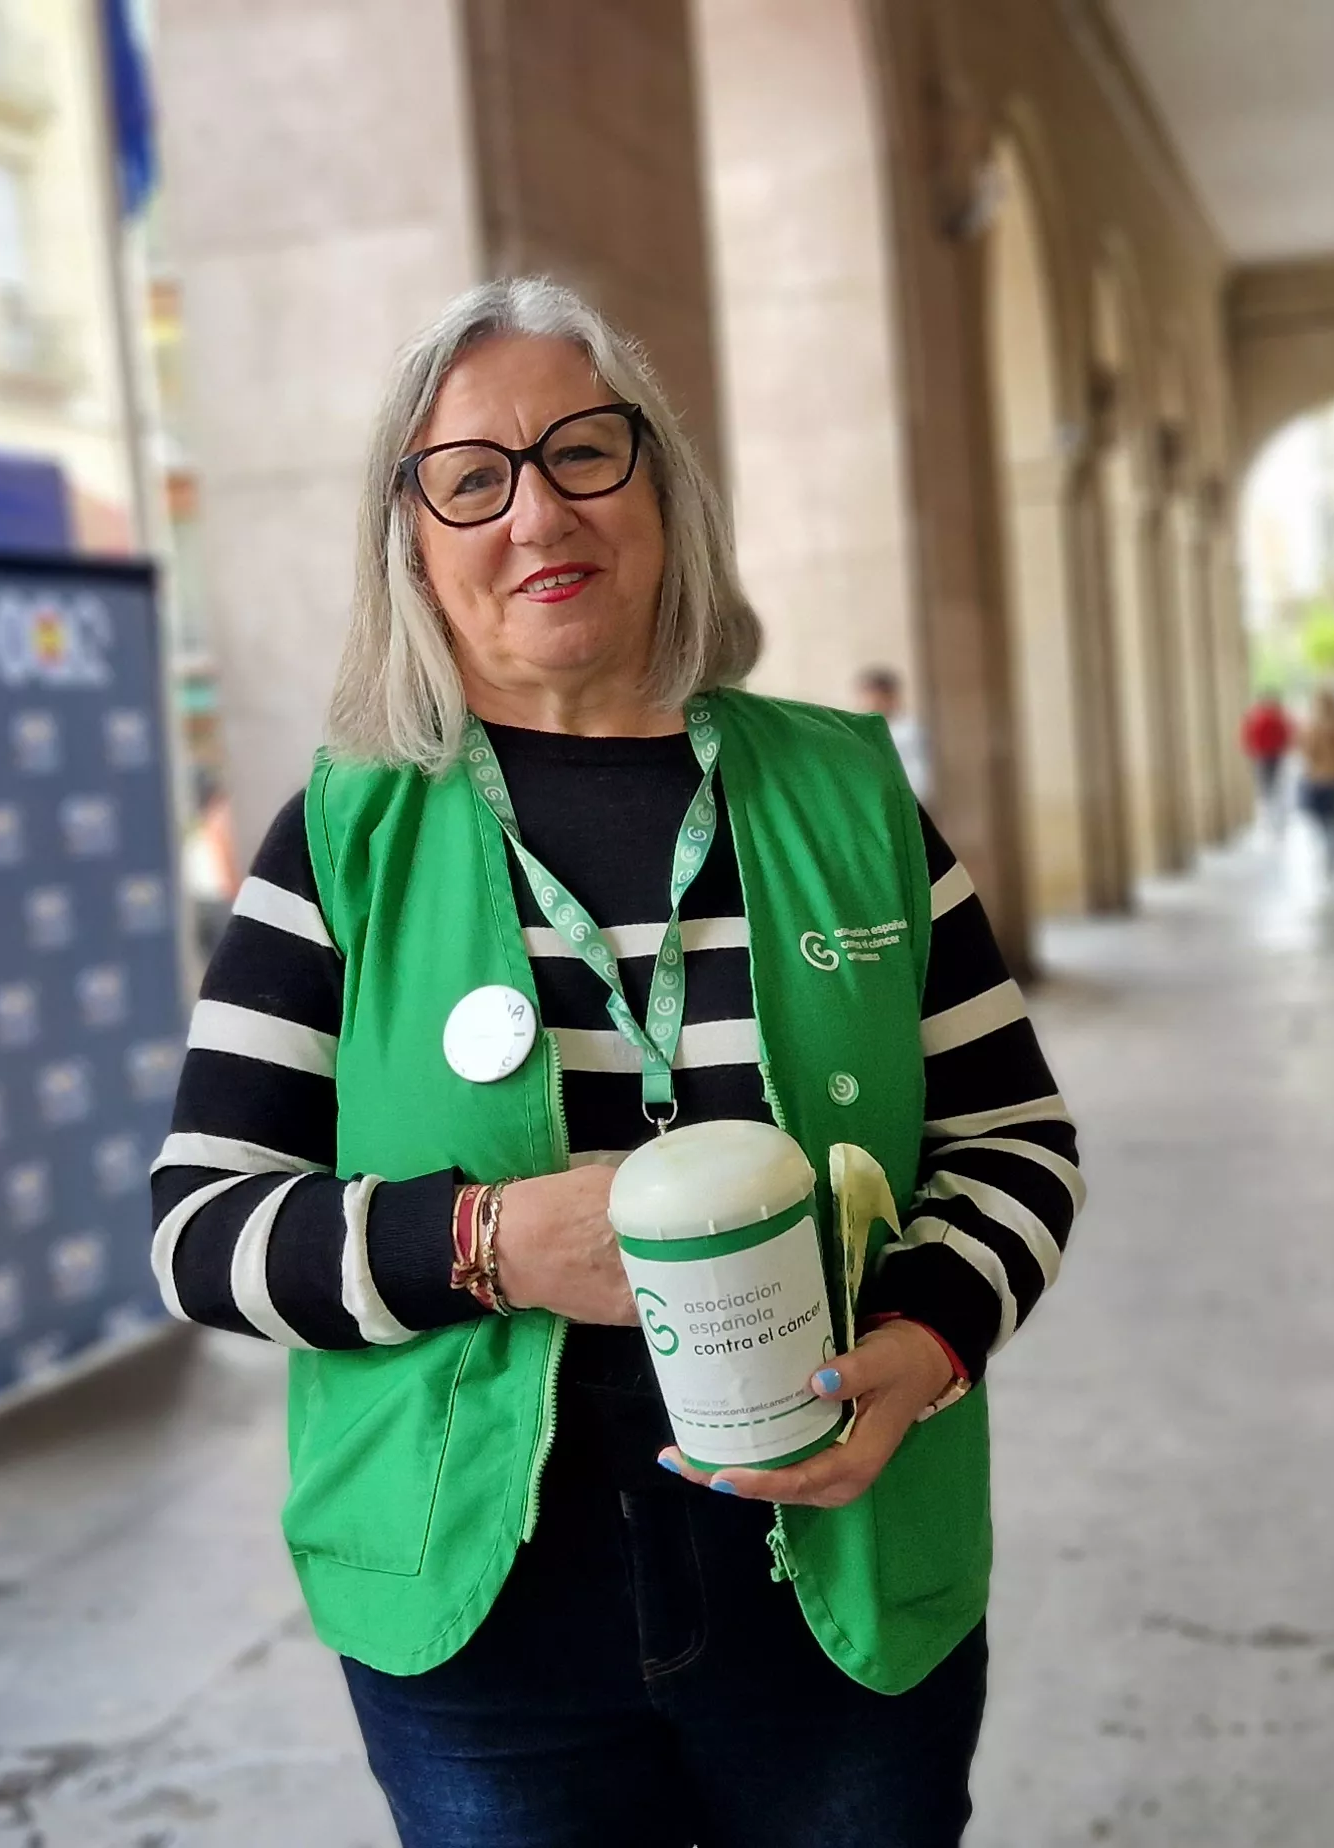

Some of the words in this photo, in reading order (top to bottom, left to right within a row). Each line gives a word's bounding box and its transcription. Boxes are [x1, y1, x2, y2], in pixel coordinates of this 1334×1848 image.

[684, 1280, 782, 1314] asociación
[689, 1307, 774, 1337] española
[694, 1338, 753, 1356] contra
[758, 1327, 774, 1345] el
[778, 1300, 821, 1338] cáncer
